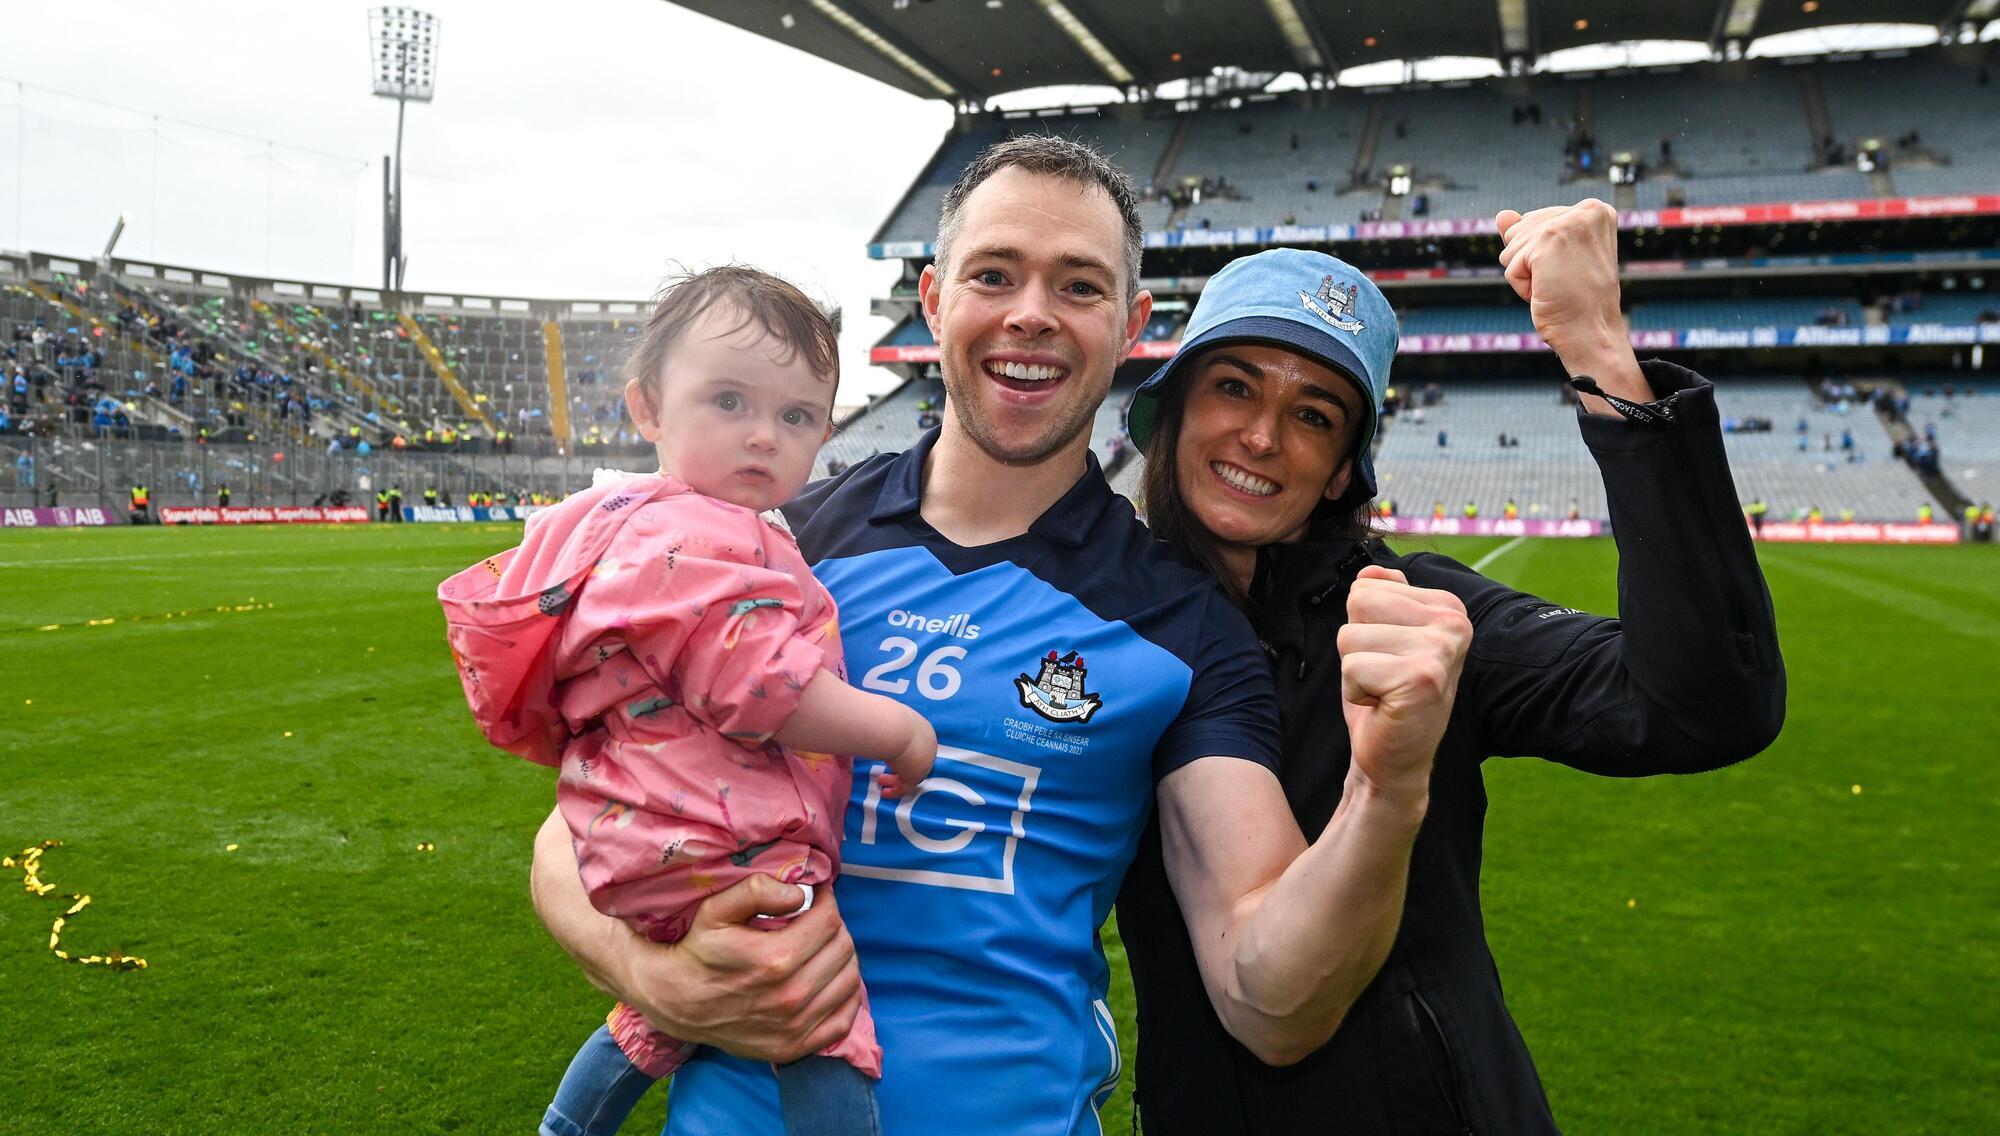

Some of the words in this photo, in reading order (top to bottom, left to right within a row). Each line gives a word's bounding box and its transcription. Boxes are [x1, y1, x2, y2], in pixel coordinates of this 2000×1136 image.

[5, 508, 37, 526] AIB
[75, 508, 105, 525] AIB
[414, 506, 458, 522] Allianz
[861, 636, 968, 701] 26
[1050, 709, 1078, 717] CLIATH
[1003, 717, 1033, 733] CRAOBH
[1034, 725, 1052, 738] PEILE
[1052, 731, 1062, 740] NA
[1063, 732, 1090, 747] SINSEAR
[1005, 728, 1036, 745] CLUICHE
[1036, 736, 1069, 753] CEANNAIS
[1068, 743, 1083, 755] 2023
[844, 764, 986, 853] IG
